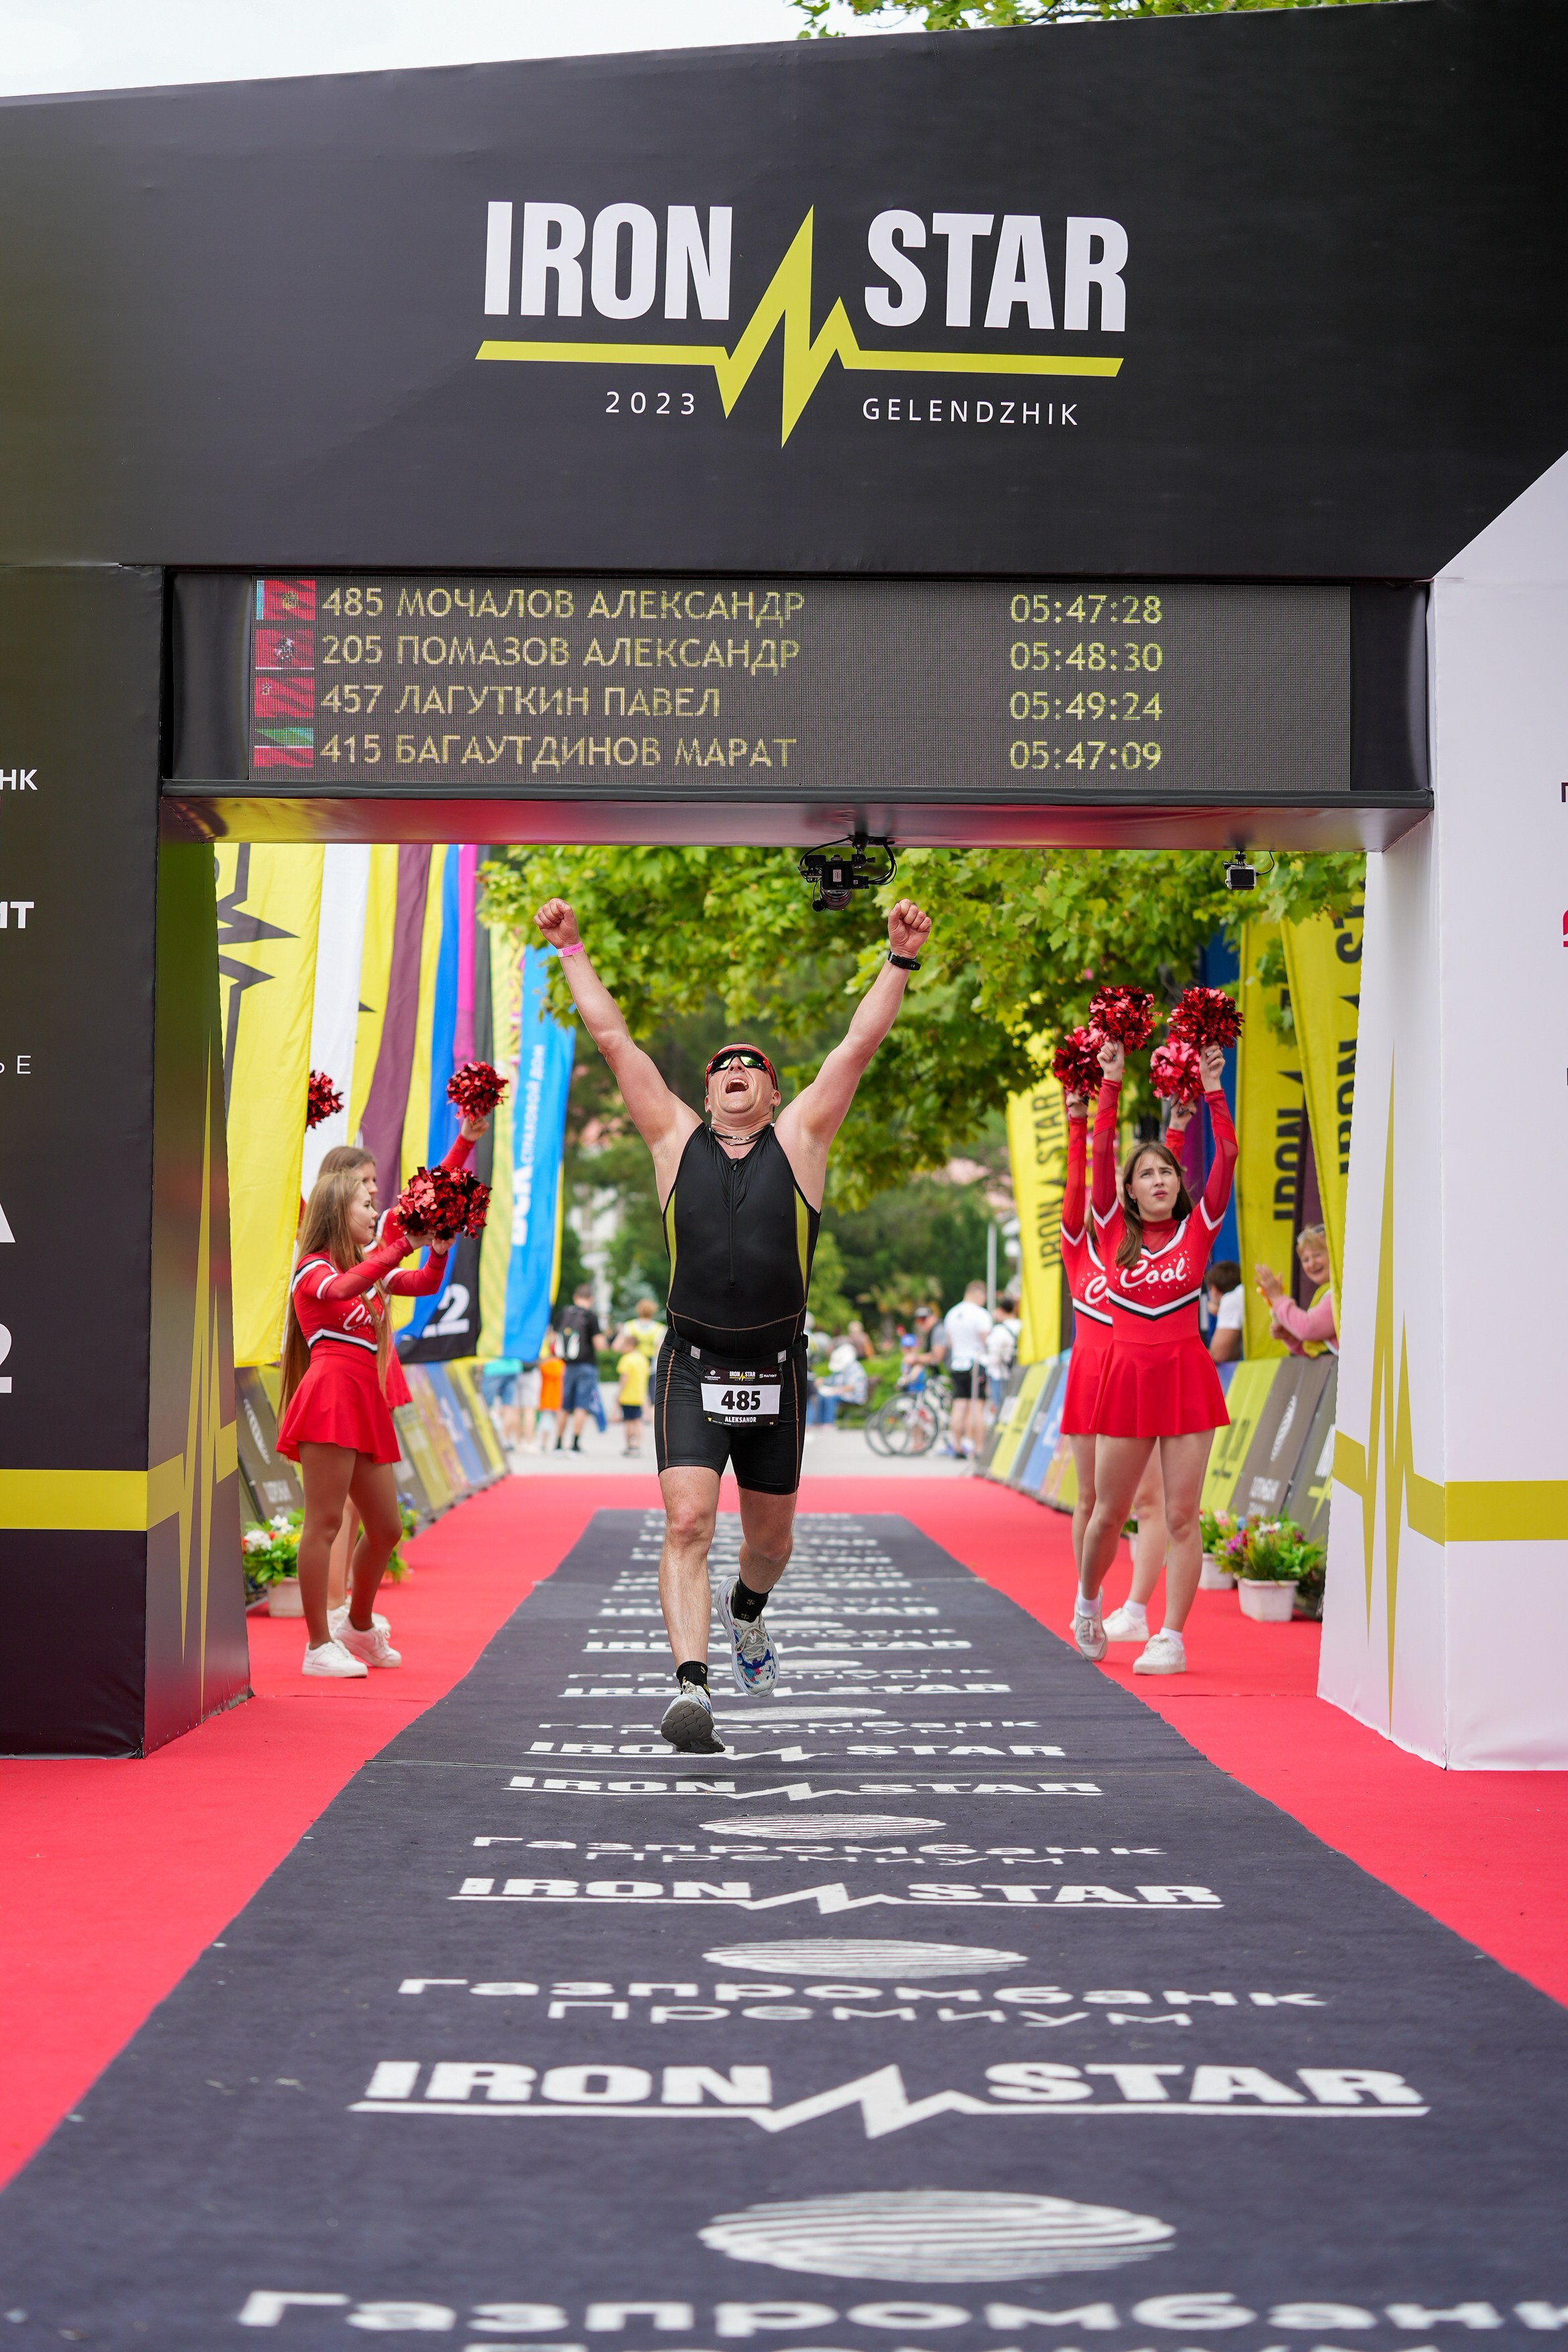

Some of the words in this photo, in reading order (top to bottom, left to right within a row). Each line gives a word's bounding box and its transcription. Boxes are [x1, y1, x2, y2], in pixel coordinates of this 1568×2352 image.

[485, 201, 732, 320] IRON
[865, 210, 1128, 332] STAR
[606, 391, 694, 414] 2023
[863, 398, 1077, 425] GELENDZHIK
[323, 587, 383, 616] 485
[397, 587, 575, 618] МОЧАЛОВ
[588, 589, 804, 628] АЛЕКСАНДР
[1010, 593, 1163, 624] 05:47:28
[324, 634, 381, 664] 205
[397, 635, 571, 665] ПОМАЗОВ
[583, 637, 799, 675] АЛЕКСАНДР
[1010, 641, 1163, 671] 05:48:30
[322, 685, 382, 713] 457
[395, 685, 589, 715] ЛАГУТКИН
[605, 687, 720, 716] ПАВЕЛ
[1010, 690, 1163, 720] 05:49:24
[320, 734, 381, 763] 415
[396, 734, 659, 772] БАГАУТДИНОВ
[675, 738, 797, 767] МАРАТ
[1010, 740, 1162, 769] 05:47:09
[1120, 1257, 1187, 1288] Cool
[721, 1390, 761, 1410] 485
[846, 1745, 1066, 1756] STAR
[508, 1776, 735, 1792] IRON
[859, 1783, 1104, 1792] STAR
[473, 1836, 1167, 1855] Газпромбанк
[585, 1853, 1063, 1865] Премиум
[459, 1878, 750, 1898] IRON
[908, 1883, 1222, 1904] STAR
[399, 1978, 1326, 2006] Газпромбанк
[548, 2001, 1191, 2027] Премиум
[364, 2061, 771, 2104] IRON
[984, 2062, 1422, 2104] STAR
